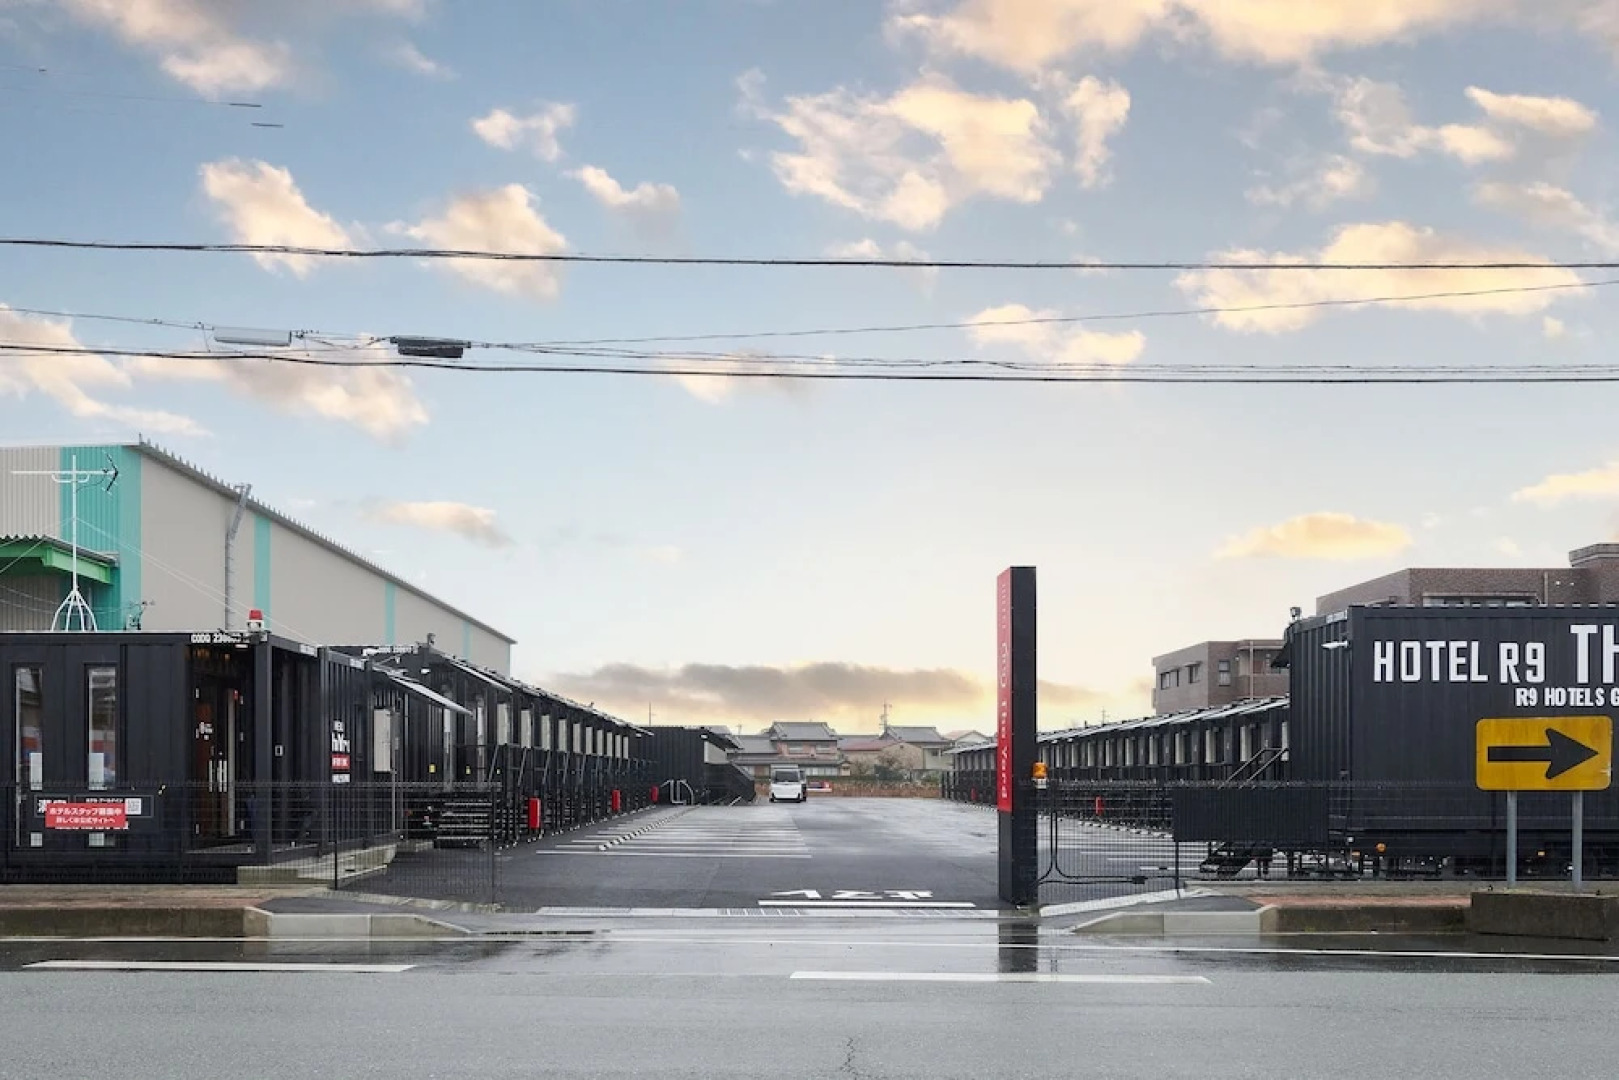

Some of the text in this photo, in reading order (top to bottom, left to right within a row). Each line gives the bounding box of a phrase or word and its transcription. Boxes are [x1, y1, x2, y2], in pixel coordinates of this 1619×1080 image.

[1373, 640, 1489, 682] HOTEL
[1499, 642, 1546, 684] R9
[1515, 687, 1538, 707] R9
[1544, 687, 1605, 707] HOTELS
